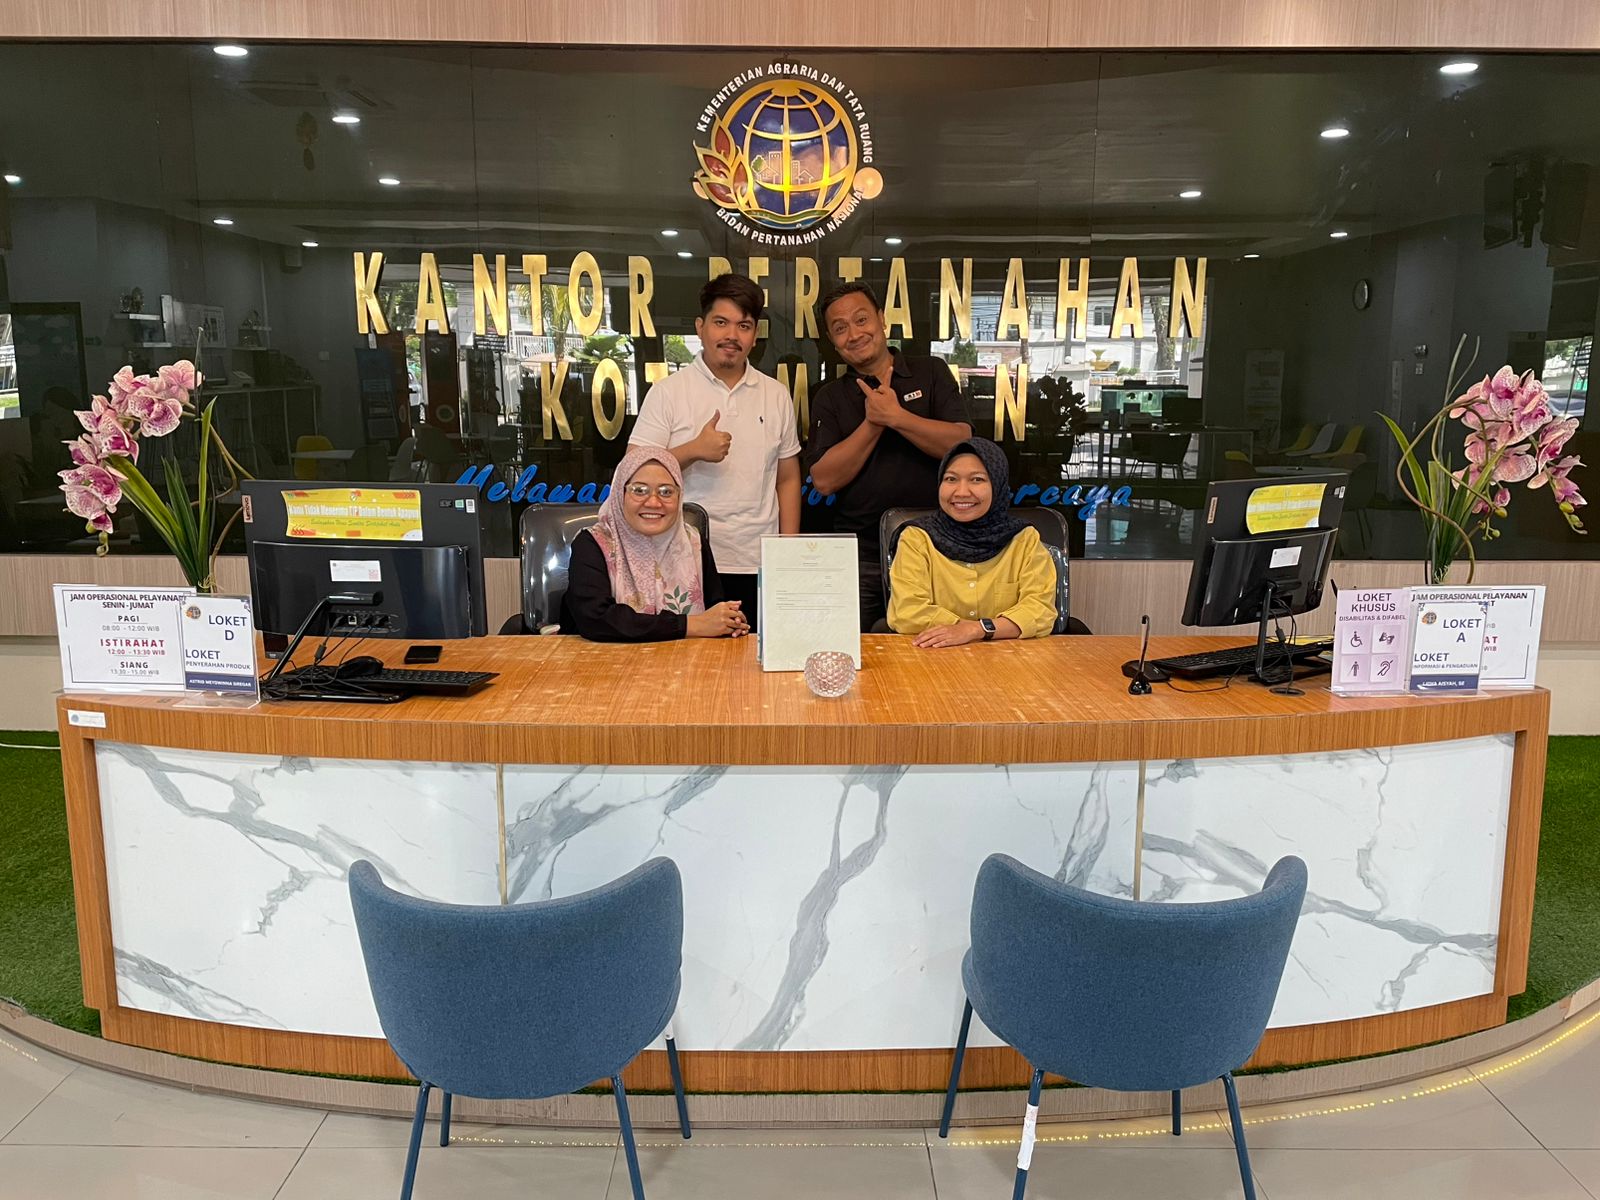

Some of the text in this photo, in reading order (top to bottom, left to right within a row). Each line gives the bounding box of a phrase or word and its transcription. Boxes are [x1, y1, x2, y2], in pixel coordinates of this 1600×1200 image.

[696, 63, 873, 164] KEMENTERIAN AGRARIA DAN TATA RUANG
[716, 207, 749, 237] BADAN
[751, 227, 826, 246] PERTANAHAN
[353, 250, 1208, 340] KANTOR ERANAHAN
[540, 358, 668, 441] KO
[70, 594, 86, 602] JAM
[86, 594, 138, 602] OPERASIONAL
[1357, 593, 1392, 602] LOKET
[1411, 593, 1429, 602] JAM
[1482, 592, 1528, 600] PELAYANAN
[129, 602, 154, 610] JUMAT
[1351, 603, 1396, 612] KHUSUS
[208, 615, 247, 626] LOKET
[1443, 618, 1482, 629] LOKET
[225, 630, 234, 641] D
[1456, 632, 1466, 643] A
[100, 639, 165, 648] ISTIRAHAT
[185, 649, 221, 660] LOKET
[1414, 653, 1449, 662] LOKET
[120, 661, 149, 669] SIANG
